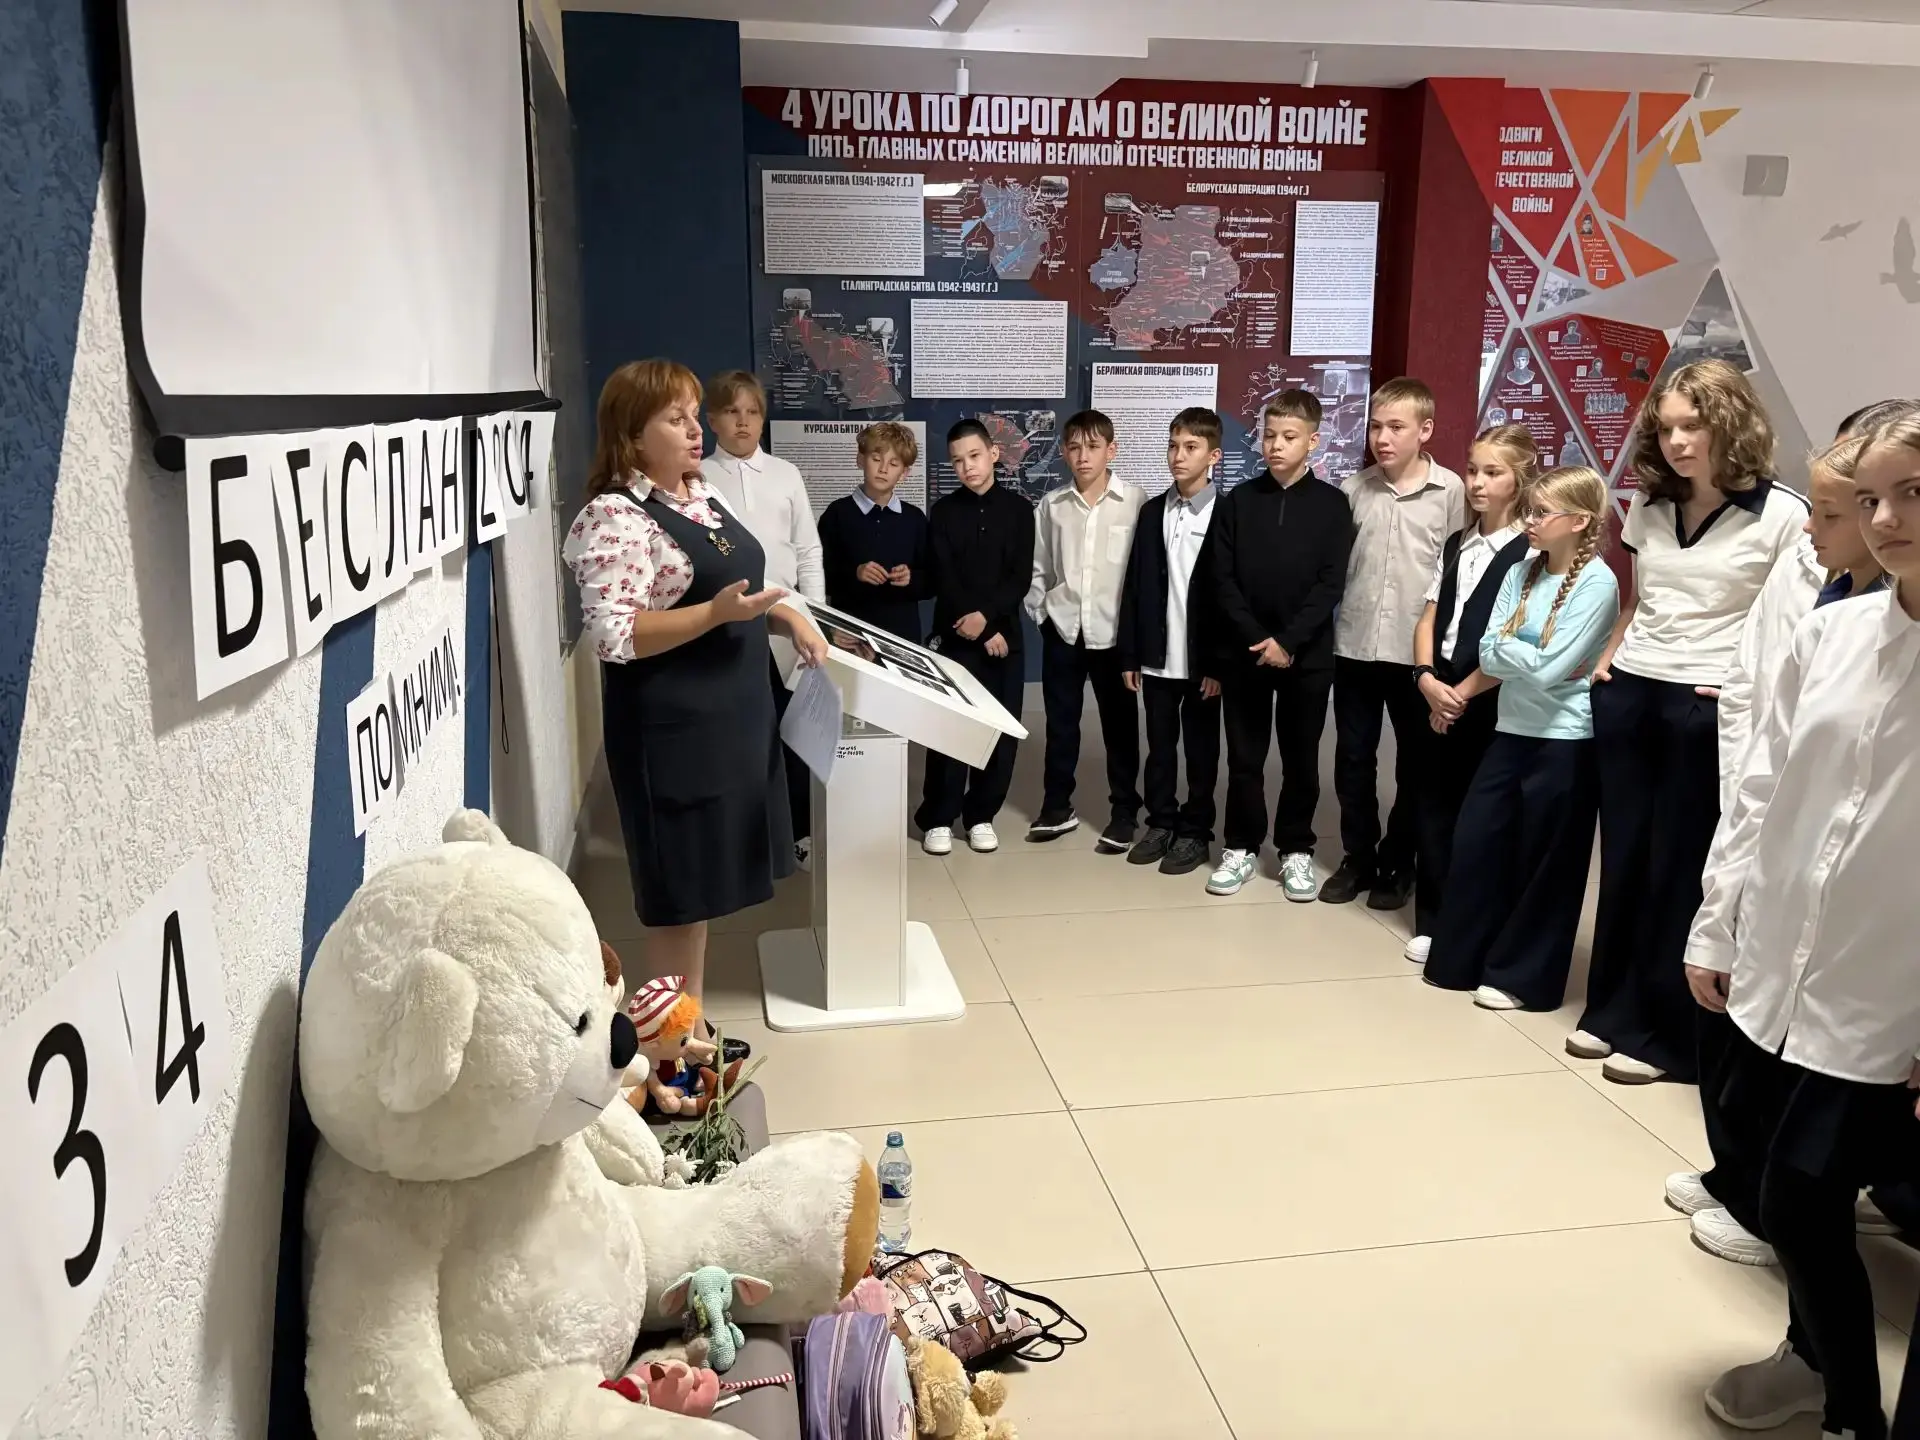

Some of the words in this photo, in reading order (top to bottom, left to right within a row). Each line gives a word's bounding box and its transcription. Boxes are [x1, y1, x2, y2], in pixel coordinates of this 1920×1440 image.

[781, 88, 804, 129] 4
[809, 89, 915, 133] УРОКА
[920, 92, 962, 134] ПО
[966, 95, 1111, 138] ДОРОГАМ
[1116, 100, 1136, 139] О
[1141, 96, 1274, 143] ВЕЛИКОЙ
[807, 134, 855, 159] ПЯТЬ
[857, 136, 945, 162] ГЛАВНЫХ
[947, 138, 1042, 166] СРАЖЕНИЙ
[1044, 139, 1124, 167] ВЕЛИКОЙ
[1126, 143, 1261, 171] ОТЕЧЕСТВЕННОЙ
[1262, 145, 1323, 172] ВОЙНЫ
[1501, 147, 1554, 167] ВЕЛИКОЙ
[771, 173, 824, 185] МОСКОВСКАЯ
[824, 174, 850, 186] БИТВА
[1186, 182, 1237, 194] БЕЛОРУССКАЯ
[1237, 184, 1276, 195] ОПЕРАЦИЯ
[1511, 193, 1554, 213] ВОЙНЫ
[841, 279, 911, 292] СТАЛИНГРАДСКАЯ
[911, 281, 936, 292] БИТВА
[1095, 365, 1143, 377] БЕРЛИНСКАЯ
[1143, 366, 1181, 377] ОПЕРАЦИЯ
[803, 423, 839, 434] КУРСКАЯ
[209, 427, 460, 660] БЕСЛАН
[356, 627, 462, 815] ПОМНИМ!
